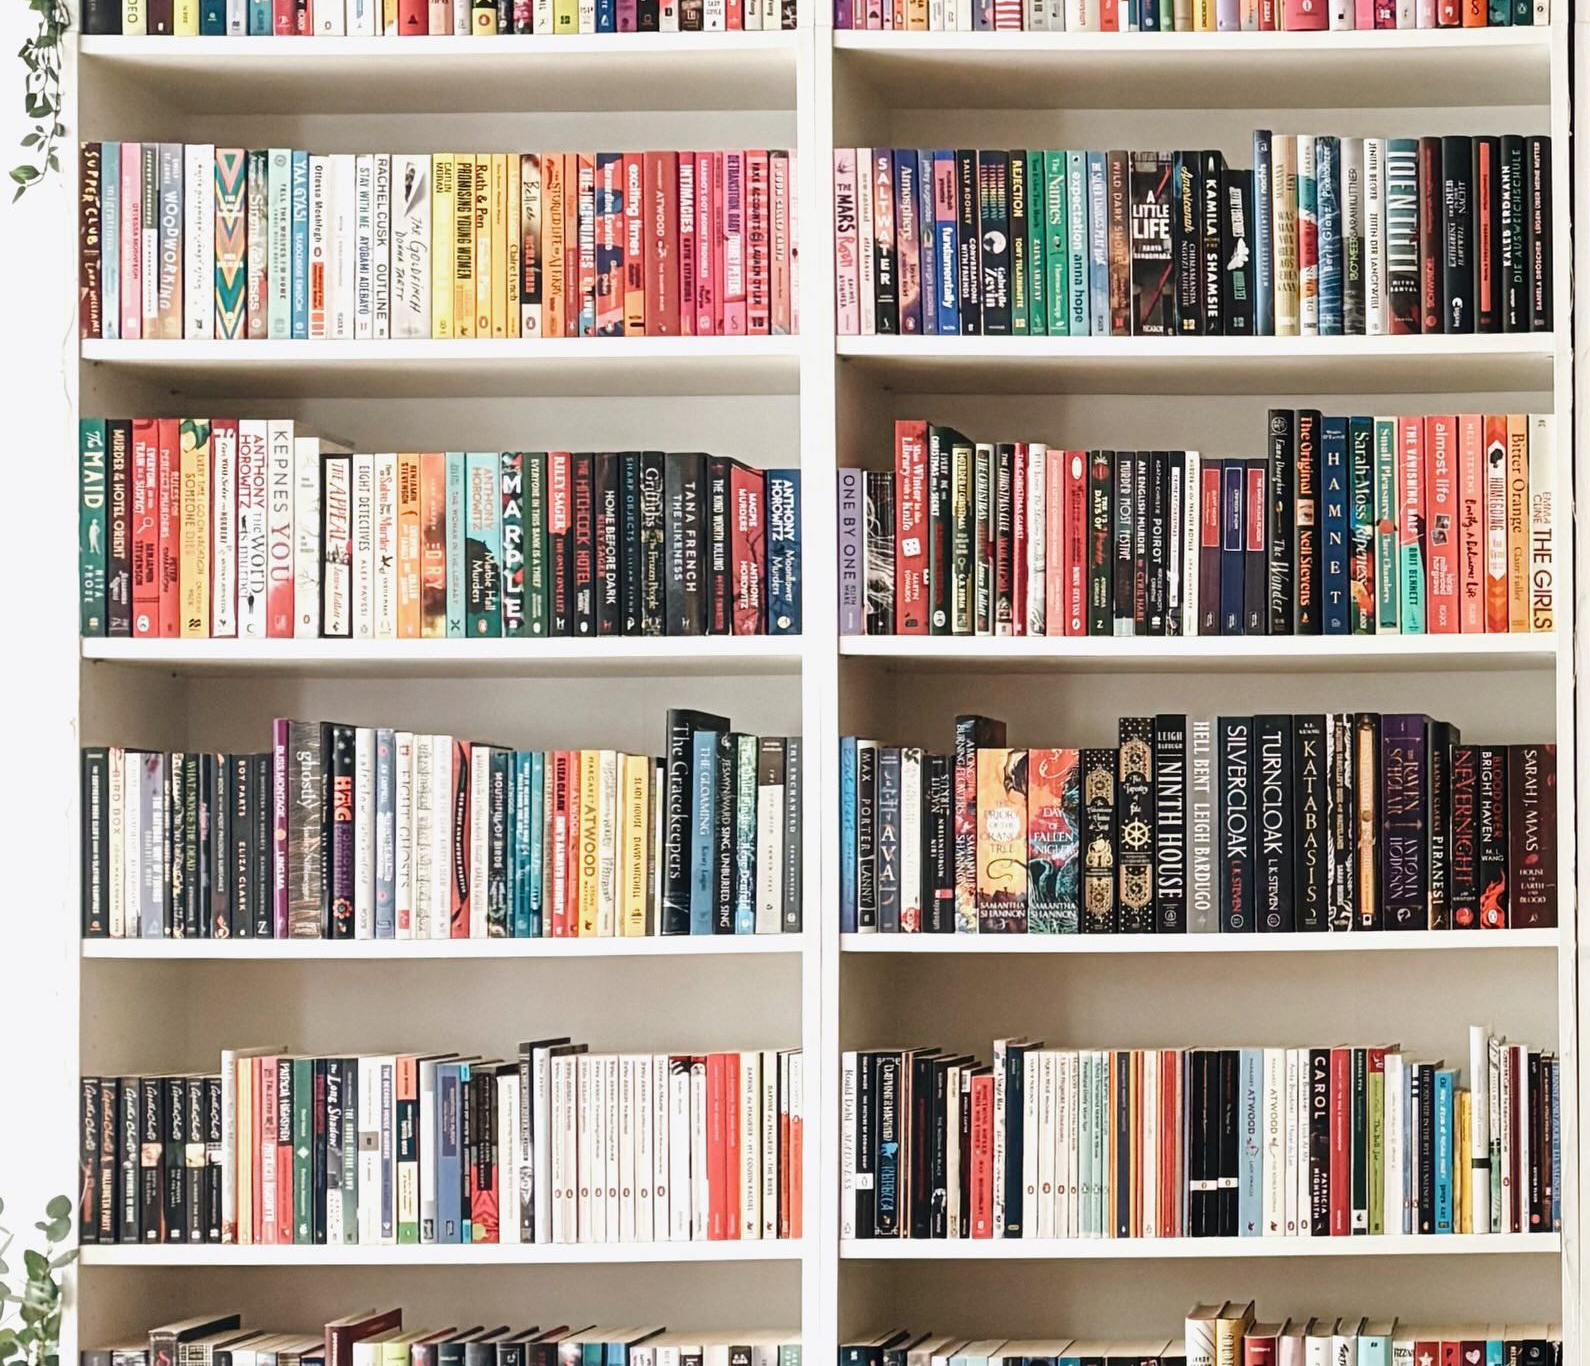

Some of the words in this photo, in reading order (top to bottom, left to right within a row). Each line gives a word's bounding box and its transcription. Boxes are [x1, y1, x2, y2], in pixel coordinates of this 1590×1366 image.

[377, 159, 387, 208] RACHEL
[1131, 205, 1169, 218] LITTLE
[1145, 190, 1154, 203] A
[1206, 179, 1217, 234] KAMILA
[377, 212, 387, 246] CUSK
[878, 158, 892, 285] SALTWATER
[1132, 219, 1169, 239] LIFE
[377, 264, 387, 320] OUTLINE
[942, 227, 955, 308] fundamentally
[1206, 253, 1217, 317] SHAMSIE
[274, 431, 288, 512] KEPNES
[1512, 434, 1526, 475] Bitter
[686, 482, 696, 522] TANA
[772, 480, 783, 541] HOROWITZ
[784, 480, 795, 541] ANTHONY
[844, 475, 856, 509] ONE
[1510, 479, 1524, 532] Orange
[270, 523, 290, 583] YOU
[503, 475, 522, 617] MARPLE
[844, 517, 856, 538] BY
[1328, 453, 1340, 603] HAMNET
[1534, 529, 1552, 563] THE
[686, 530, 696, 592] FRENCH
[844, 544, 856, 579] ONE
[1534, 570, 1552, 629] GIRLS
[672, 722, 690, 755] The
[1194, 722, 1210, 754] HELL
[1158, 762, 1182, 825] NINTH
[1194, 759, 1210, 793] BENT
[1228, 726, 1247, 857] SILVERCLOAK
[1263, 731, 1282, 854] TURNCLOAK
[1525, 750, 1538, 795] SARAH
[666, 761, 689, 878] Gracekeepers
[1194, 803, 1210, 842] LEIGH
[1304, 741, 1317, 902] KATABASIS
[1526, 811, 1538, 851] MAAS
[1158, 834, 1182, 898] HOUSE
[1194, 847, 1210, 910] BARDUGO
[1432, 836, 1444, 904] PIRANESI
[1314, 1057, 1326, 1119] CAROL
